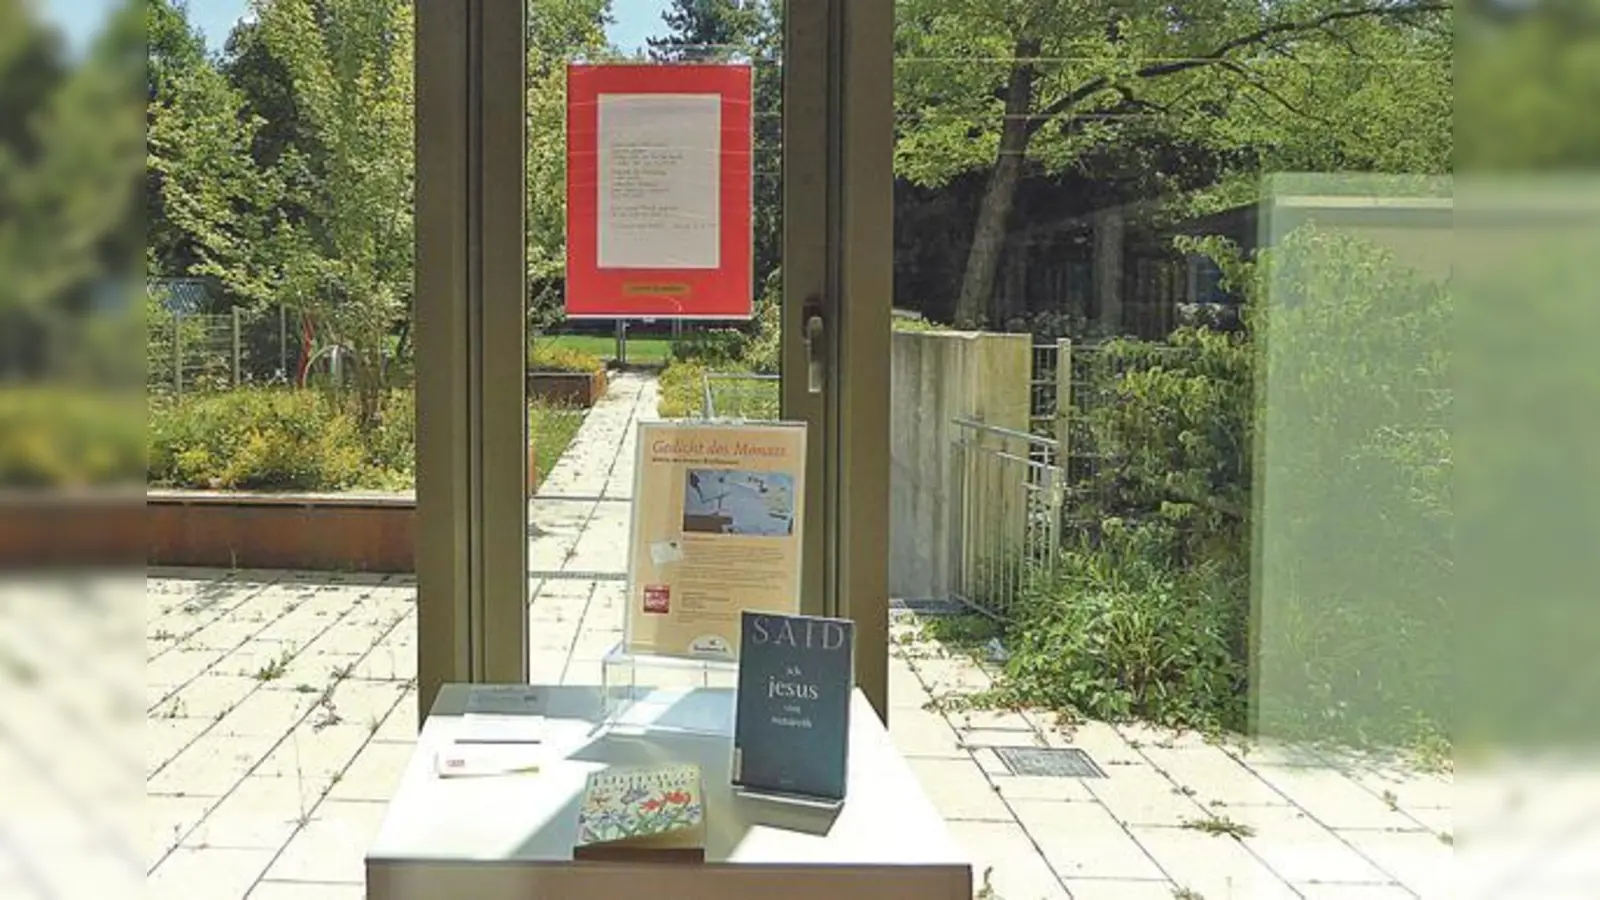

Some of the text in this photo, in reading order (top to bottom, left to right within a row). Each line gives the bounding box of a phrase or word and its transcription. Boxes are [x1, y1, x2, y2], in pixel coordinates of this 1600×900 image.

[652, 439, 787, 457] Gedicht des Monats
[752, 616, 845, 650] SAID
[768, 675, 819, 701] jesus
